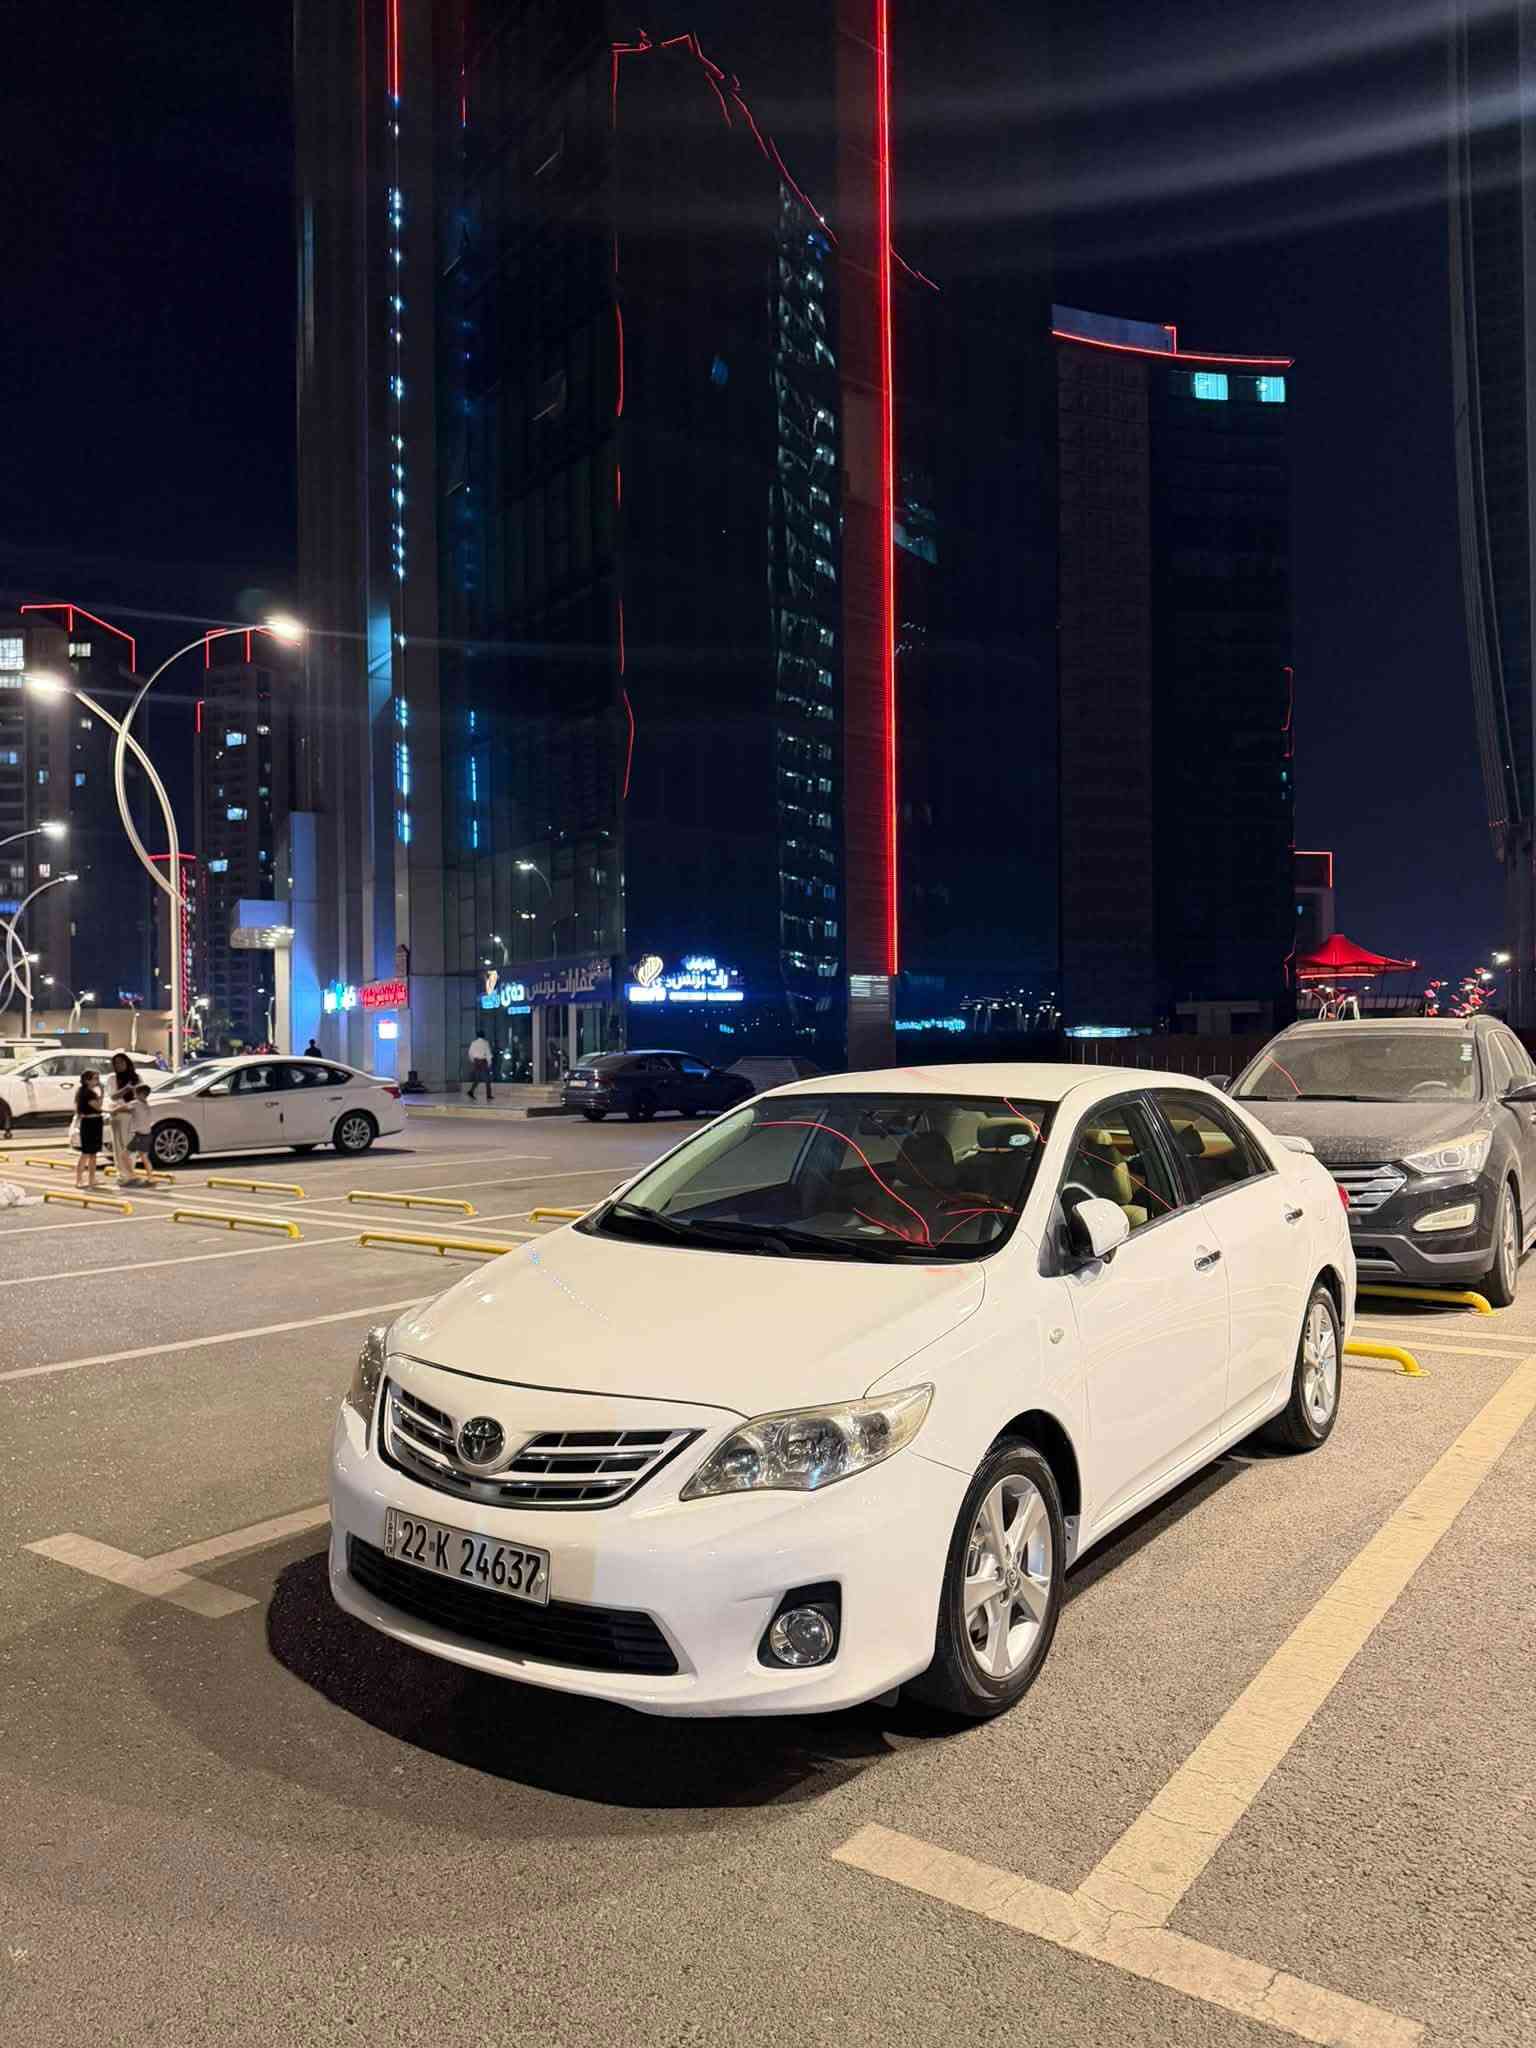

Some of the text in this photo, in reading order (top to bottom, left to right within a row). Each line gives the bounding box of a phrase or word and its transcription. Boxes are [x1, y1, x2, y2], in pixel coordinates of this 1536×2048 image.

[401, 1521, 427, 1561] 22
[436, 1530, 450, 1569] K
[460, 1538, 541, 1594] 24637
